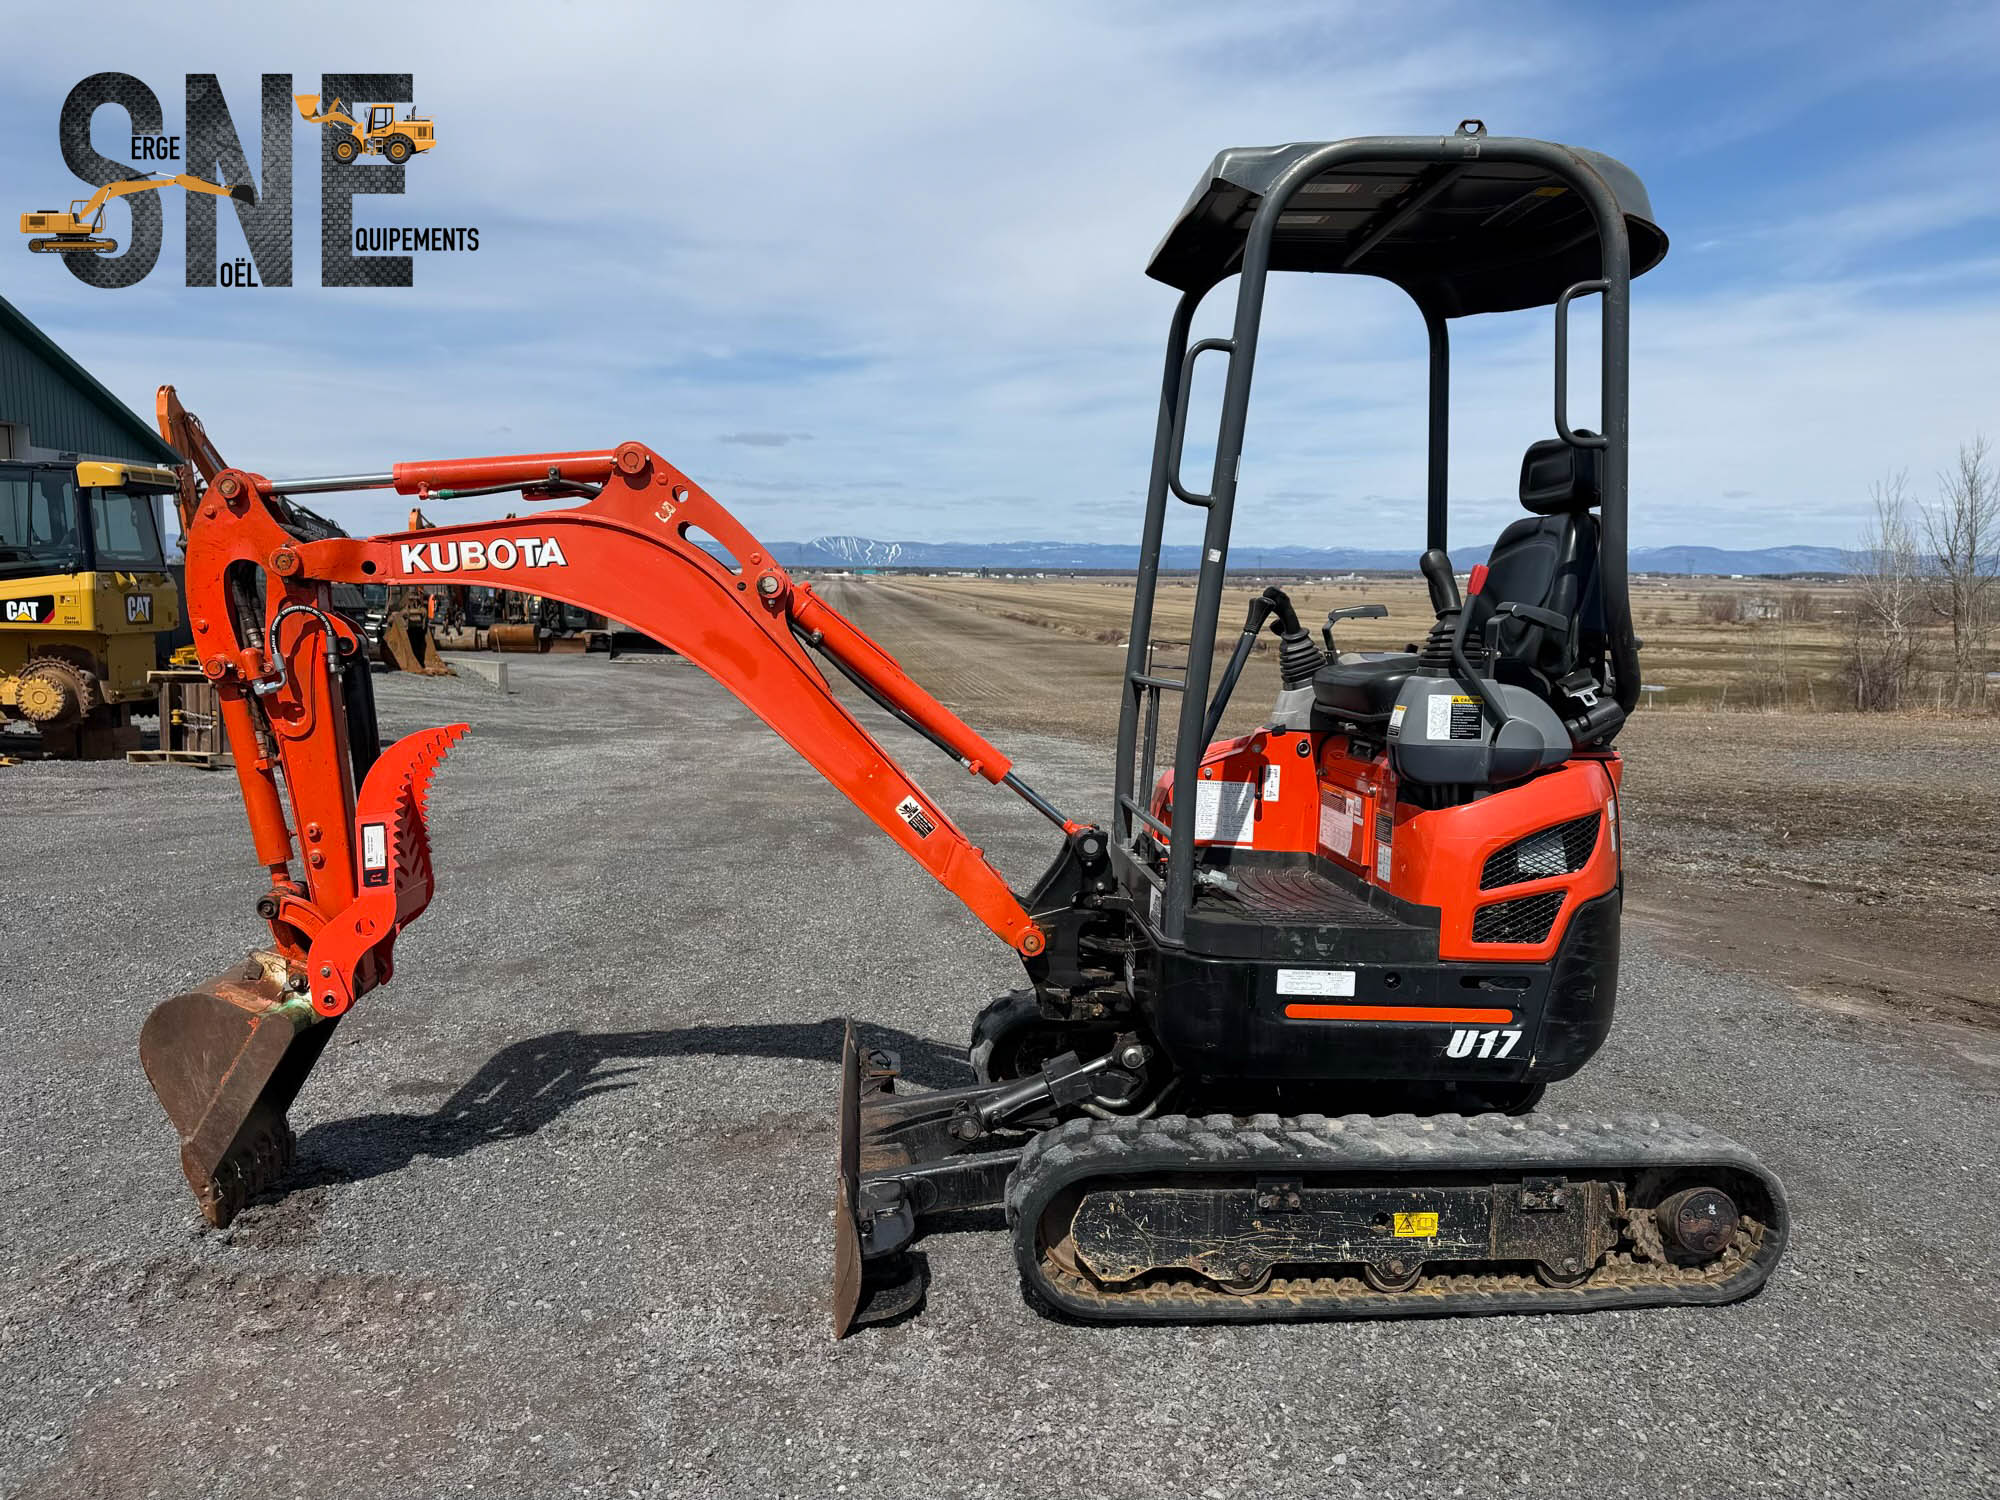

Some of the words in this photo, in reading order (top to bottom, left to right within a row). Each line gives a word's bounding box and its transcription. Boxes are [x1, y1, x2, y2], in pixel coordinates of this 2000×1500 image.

[400, 537, 568, 574] KUBOTA
[6, 600, 39, 621] CAT
[127, 596, 150, 622] CAT
[1446, 1030, 1523, 1059] U17
